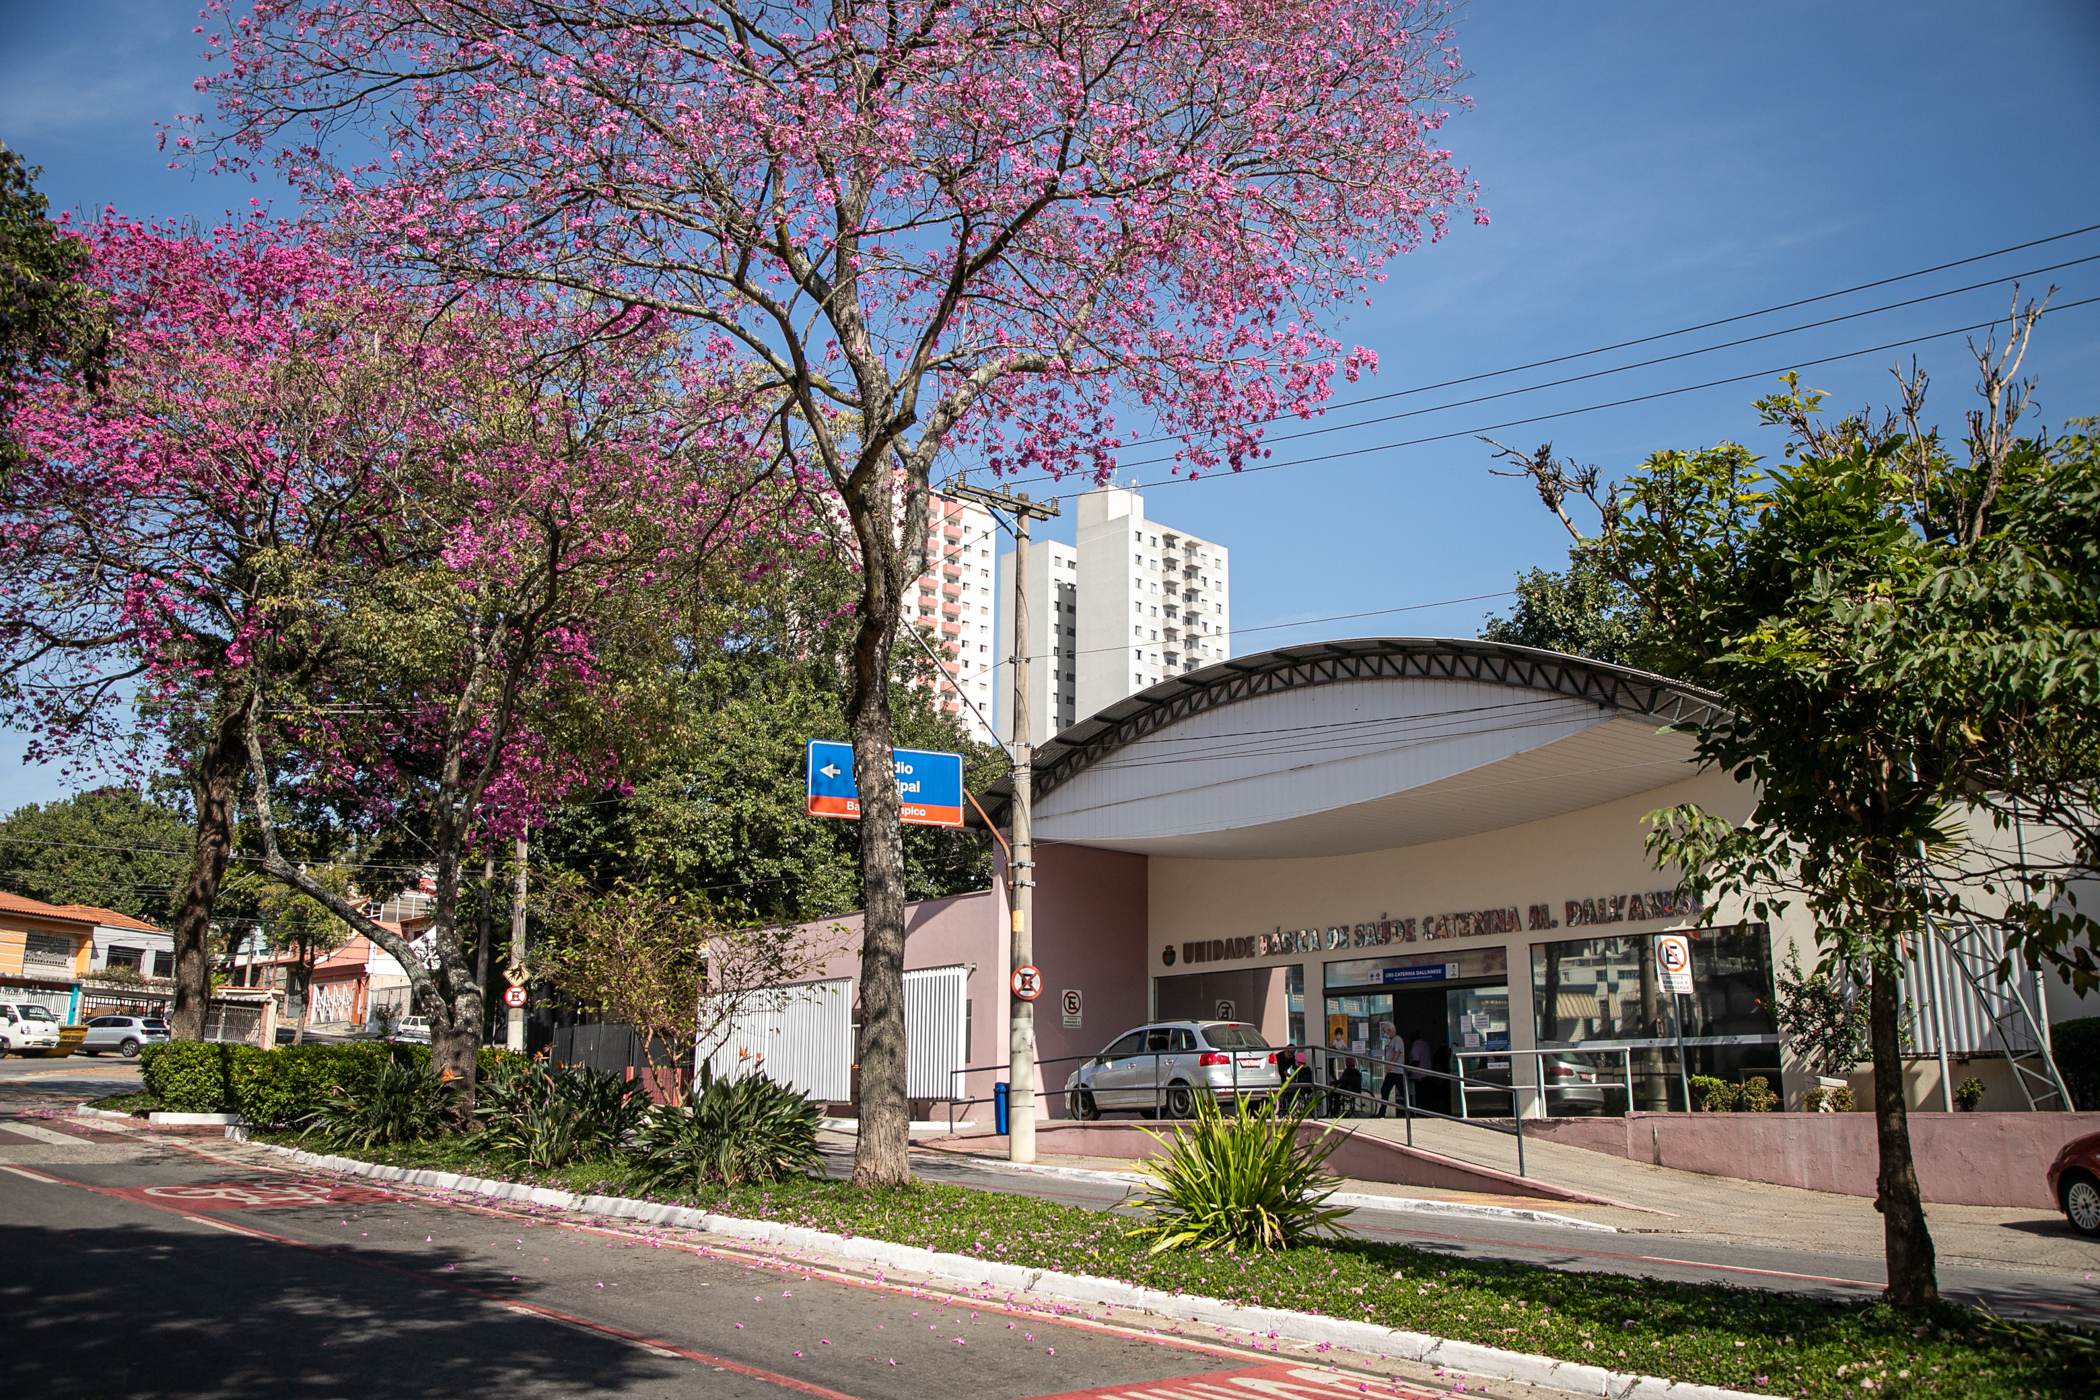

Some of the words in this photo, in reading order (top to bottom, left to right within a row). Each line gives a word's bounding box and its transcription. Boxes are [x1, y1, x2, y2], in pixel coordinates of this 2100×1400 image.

[1183, 935, 1255, 964] UNIDADE
[1259, 926, 1322, 957] BÁSICA
[1325, 925, 1350, 951] DE
[1354, 912, 1417, 948] SAÚDE
[1421, 906, 1522, 941] CATERINA
[1528, 904, 1559, 931] M.
